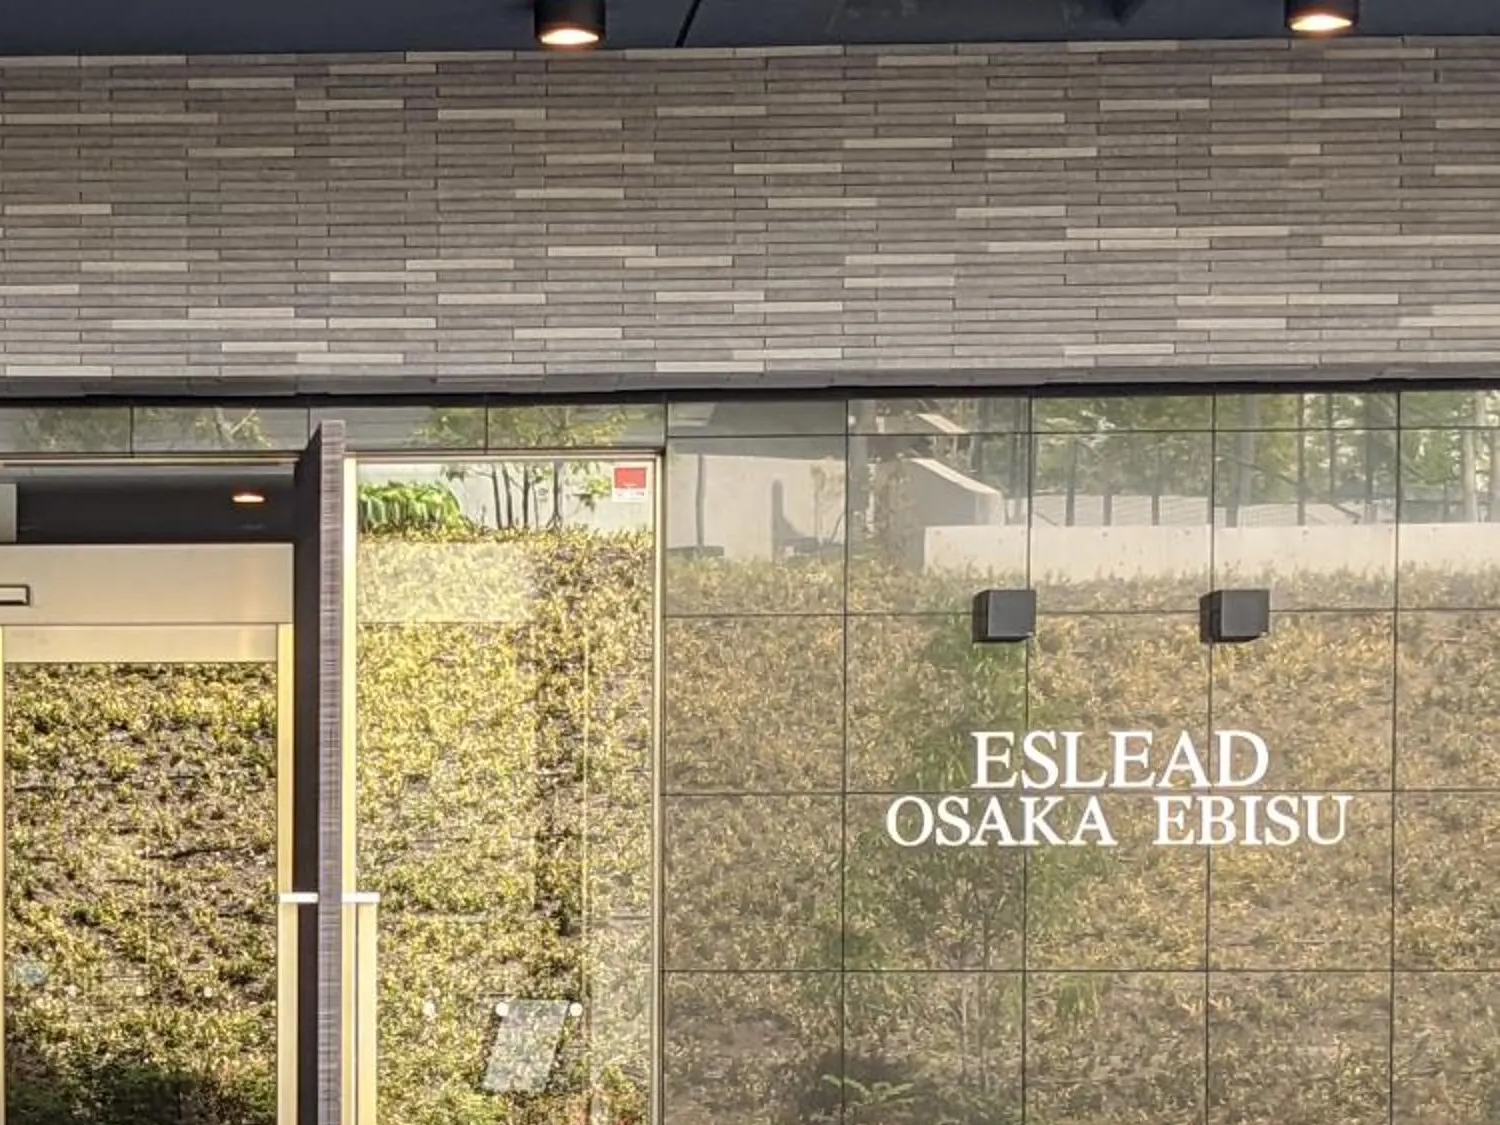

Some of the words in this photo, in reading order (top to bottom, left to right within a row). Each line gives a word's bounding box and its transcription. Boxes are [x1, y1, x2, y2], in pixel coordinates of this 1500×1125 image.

[971, 729, 1269, 789] ESLEAD
[886, 795, 1118, 846] OSAKA
[1153, 795, 1353, 846] EBISU
